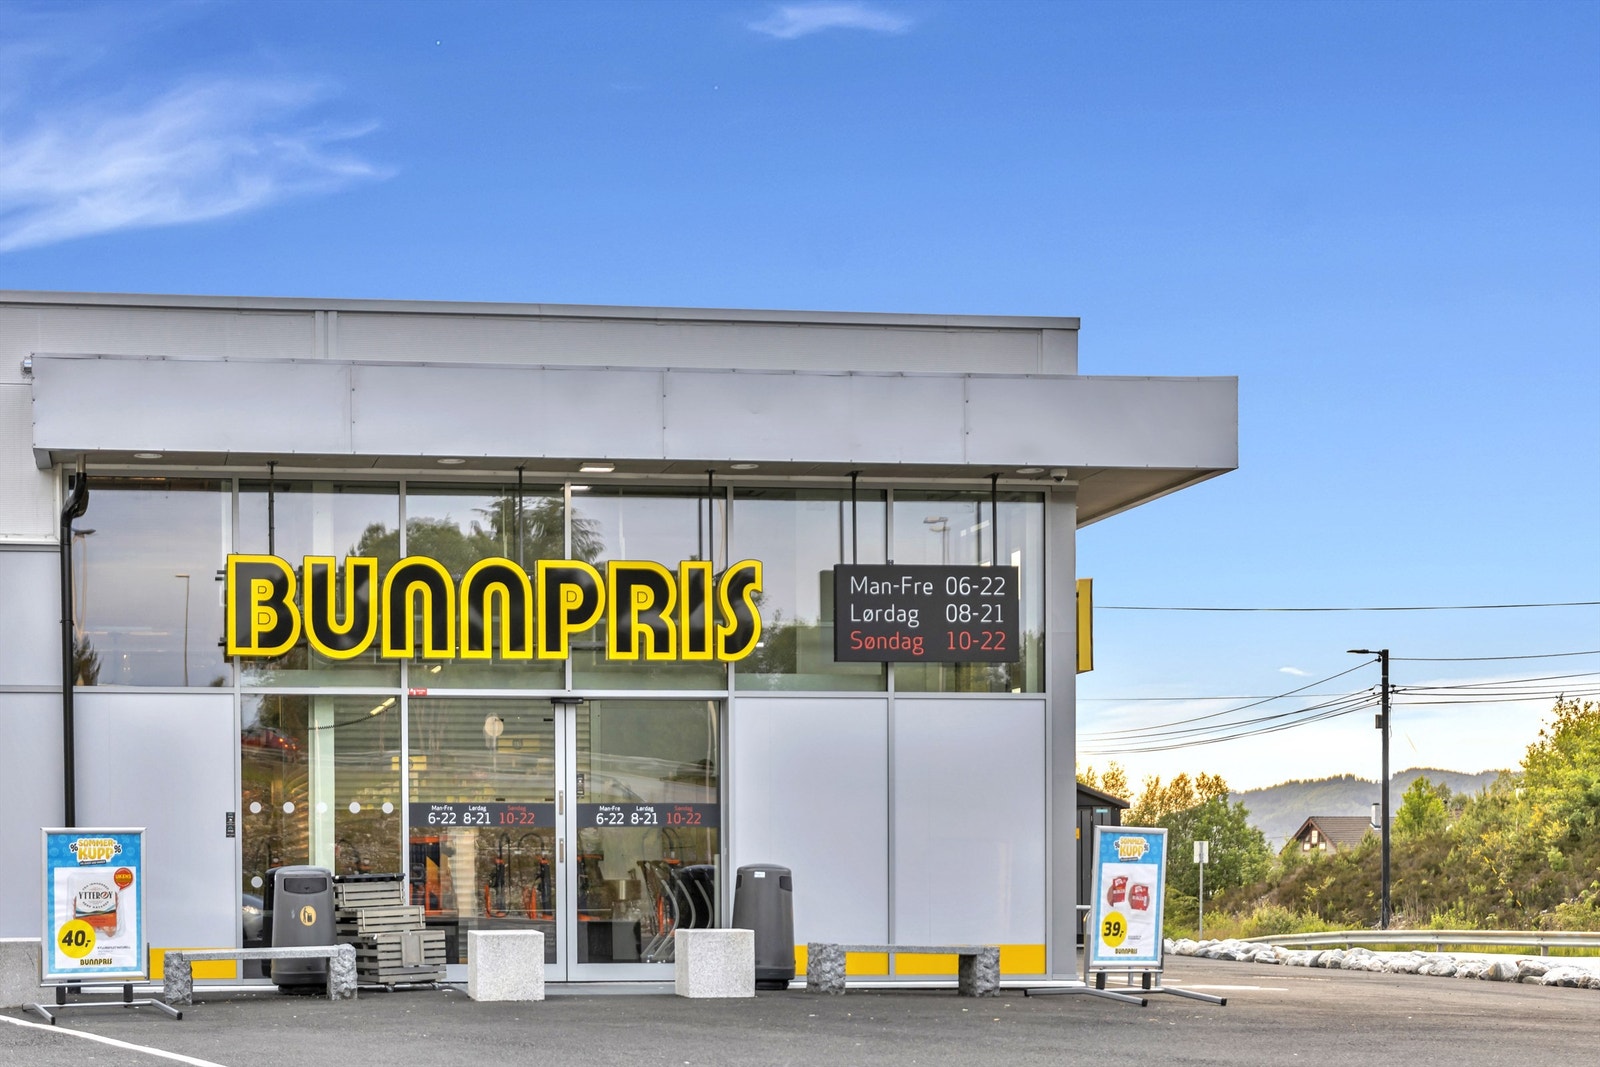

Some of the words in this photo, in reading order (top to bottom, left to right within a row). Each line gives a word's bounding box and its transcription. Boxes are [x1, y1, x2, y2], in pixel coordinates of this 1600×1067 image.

[850, 575, 934, 595] Man-Fre
[945, 576, 1006, 596] 06-22
[227, 553, 763, 662] BUNNPRIS
[850, 603, 920, 628] Lørdag
[945, 603, 1004, 623] 08-21
[850, 630, 925, 656] Søndag
[947, 631, 1007, 650] 10-22
[468, 804, 487, 813] Lørdag
[507, 804, 527, 812] Søndag
[636, 805, 654, 813] Lørdag
[428, 812, 457, 824] 6-22
[463, 812, 491, 824] 8-21
[499, 812, 536, 824] 10-22
[596, 812, 625, 825] 6-22
[630, 812, 658, 825] 8-21
[666, 812, 702, 825] 10-22
[78, 847, 114, 860] KUPP
[1120, 845, 1144, 856] KUPP
